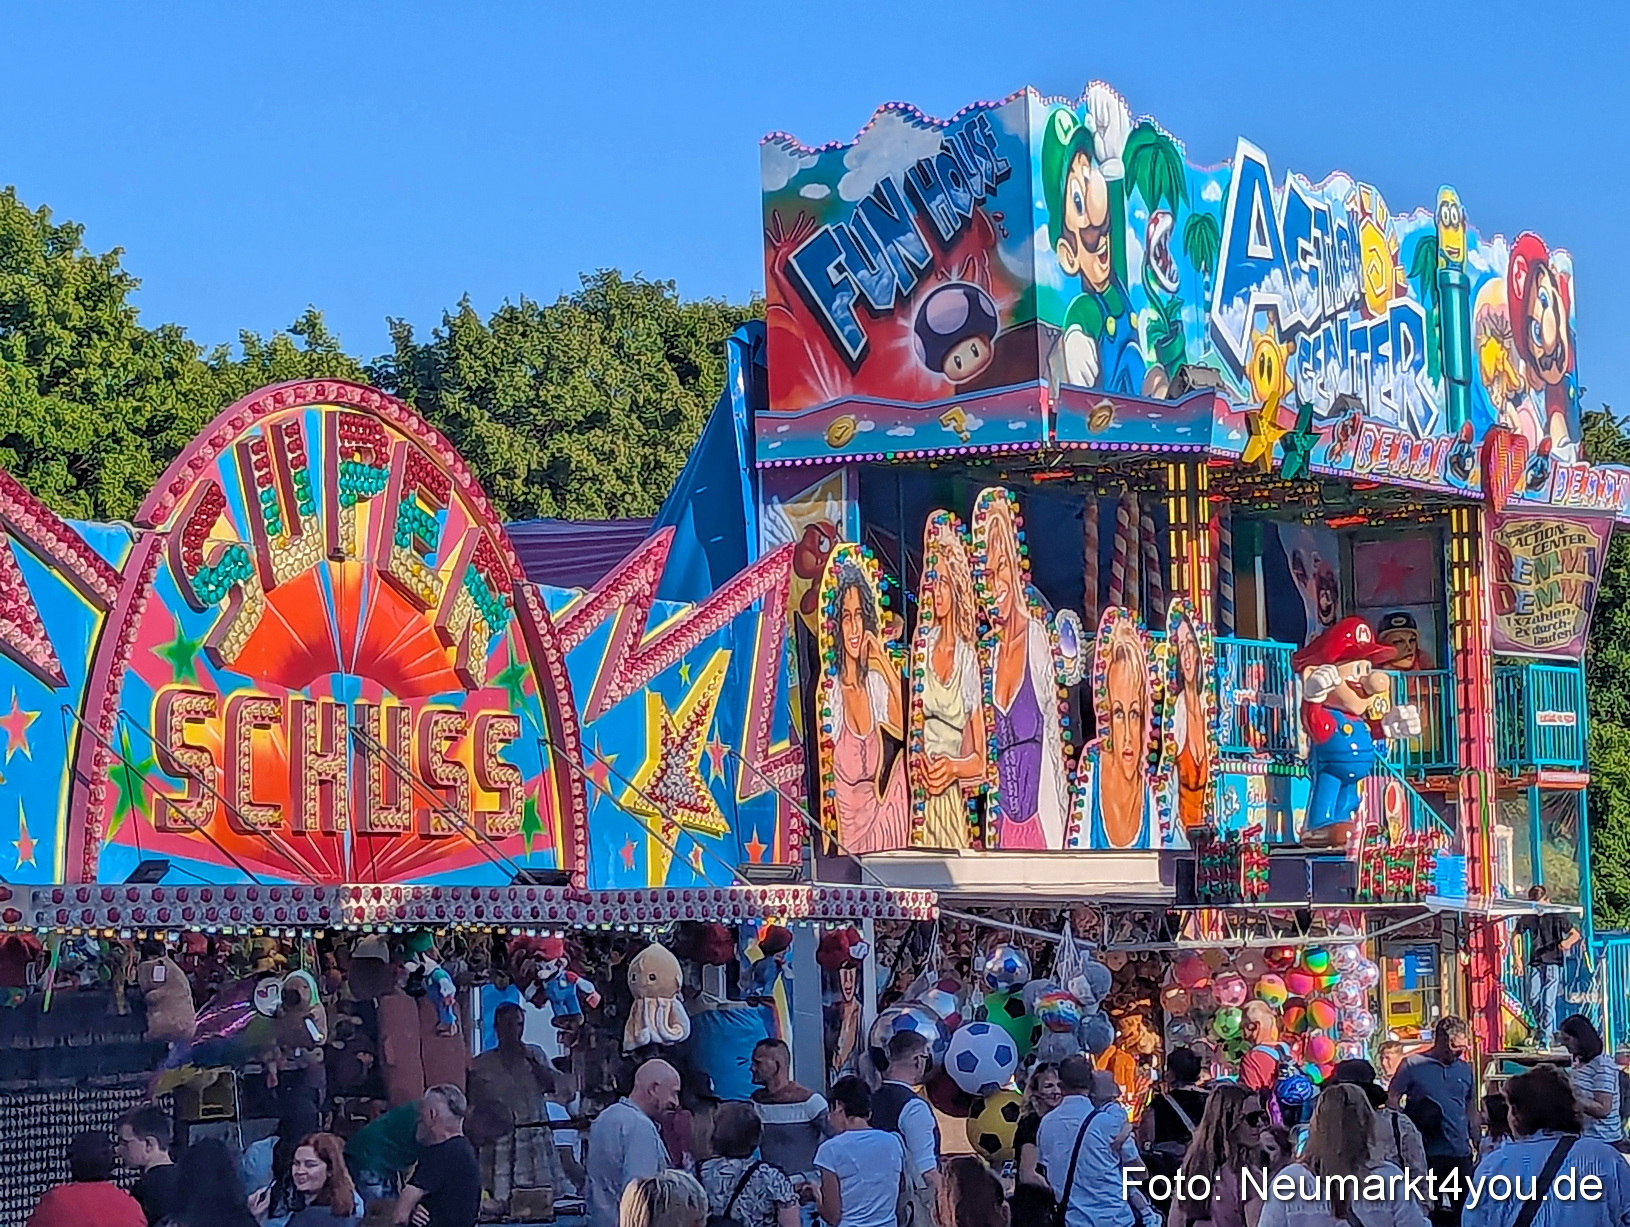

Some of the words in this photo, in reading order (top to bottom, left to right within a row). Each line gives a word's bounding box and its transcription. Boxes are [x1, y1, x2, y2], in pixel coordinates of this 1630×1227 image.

[787, 174, 934, 364] FUN
[905, 112, 1010, 242] HOUSE
[1211, 136, 1362, 368] ACTION
[1297, 297, 1438, 438] CENTER
[170, 411, 514, 690] SUPER
[1491, 541, 1597, 586] REMMI
[1492, 578, 1595, 616] DEMMI
[1532, 534, 1587, 557] CENTER
[1358, 626, 1370, 640] M
[150, 690, 524, 840] SCHUSS
